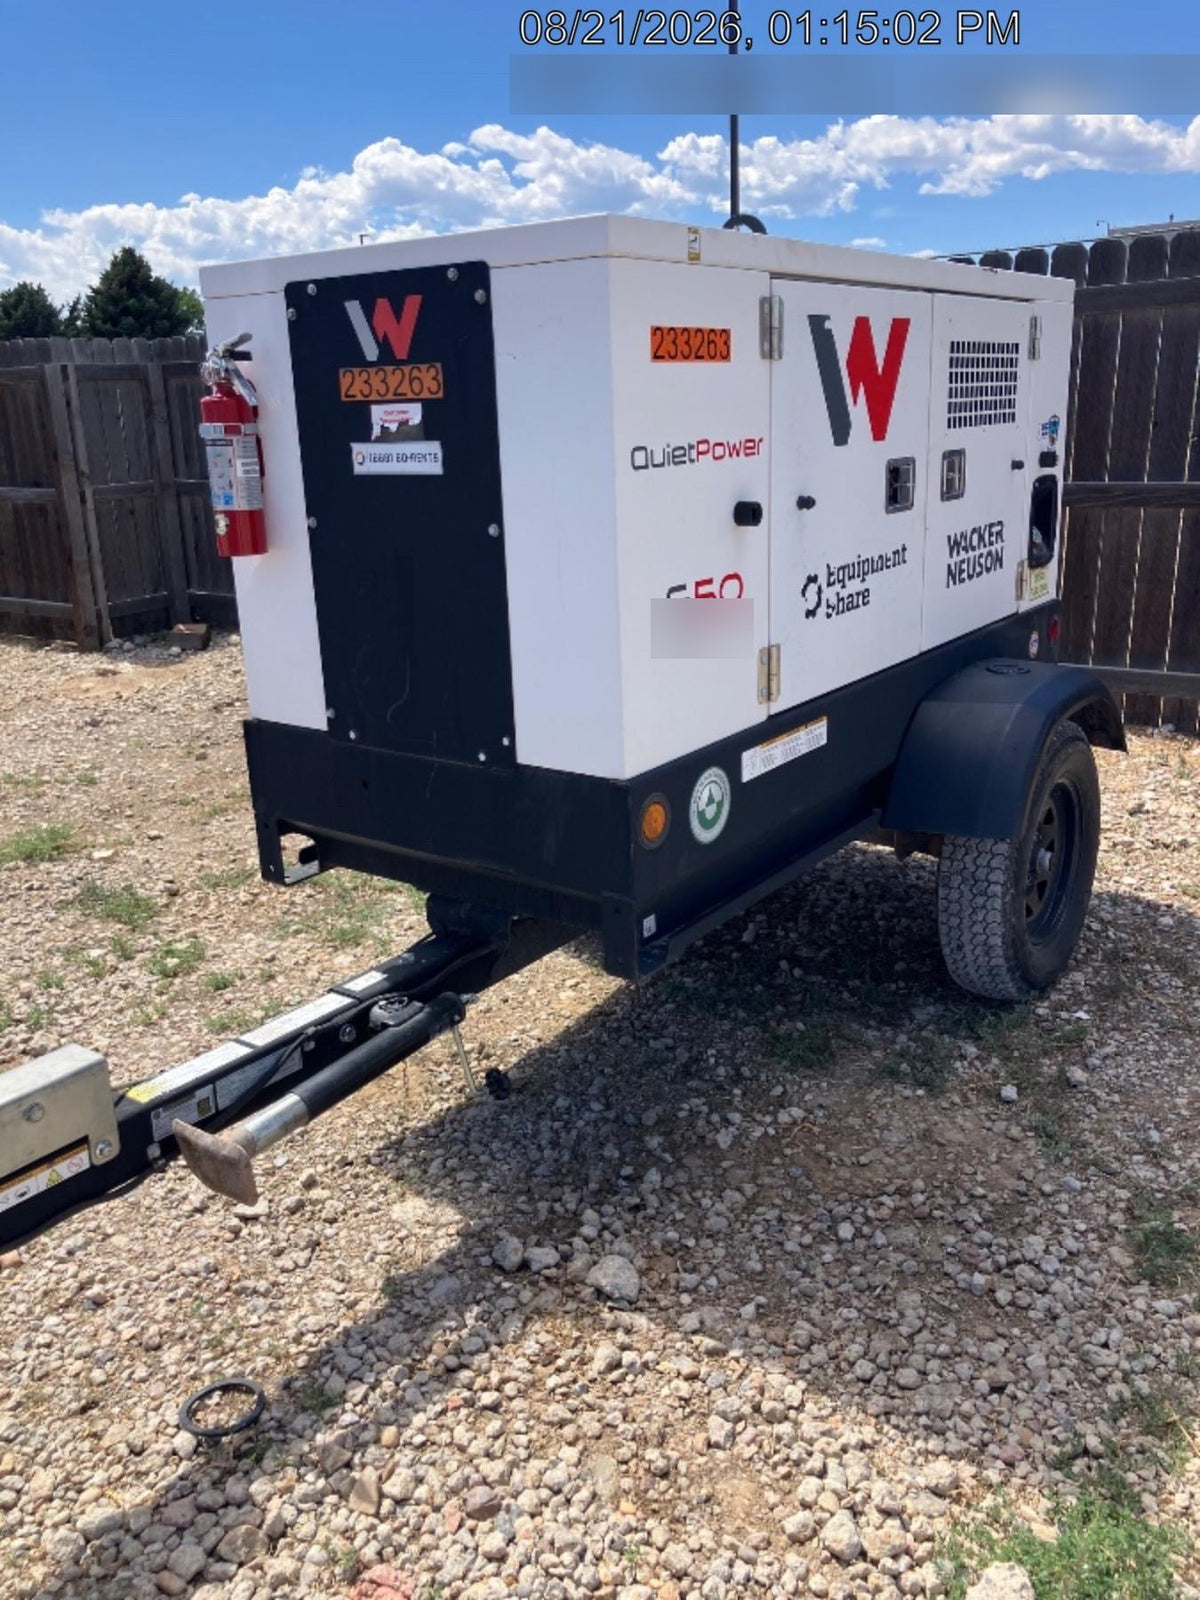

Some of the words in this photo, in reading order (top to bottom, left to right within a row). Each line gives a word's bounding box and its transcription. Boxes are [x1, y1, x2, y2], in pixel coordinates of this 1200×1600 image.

[653, 327, 730, 360] 233263
[342, 364, 442, 399] 233263
[630, 437, 764, 471] QuietPower
[947, 520, 1004, 559] WACKER
[826, 543, 908, 590] Equipment
[946, 545, 1004, 589] NEUSON
